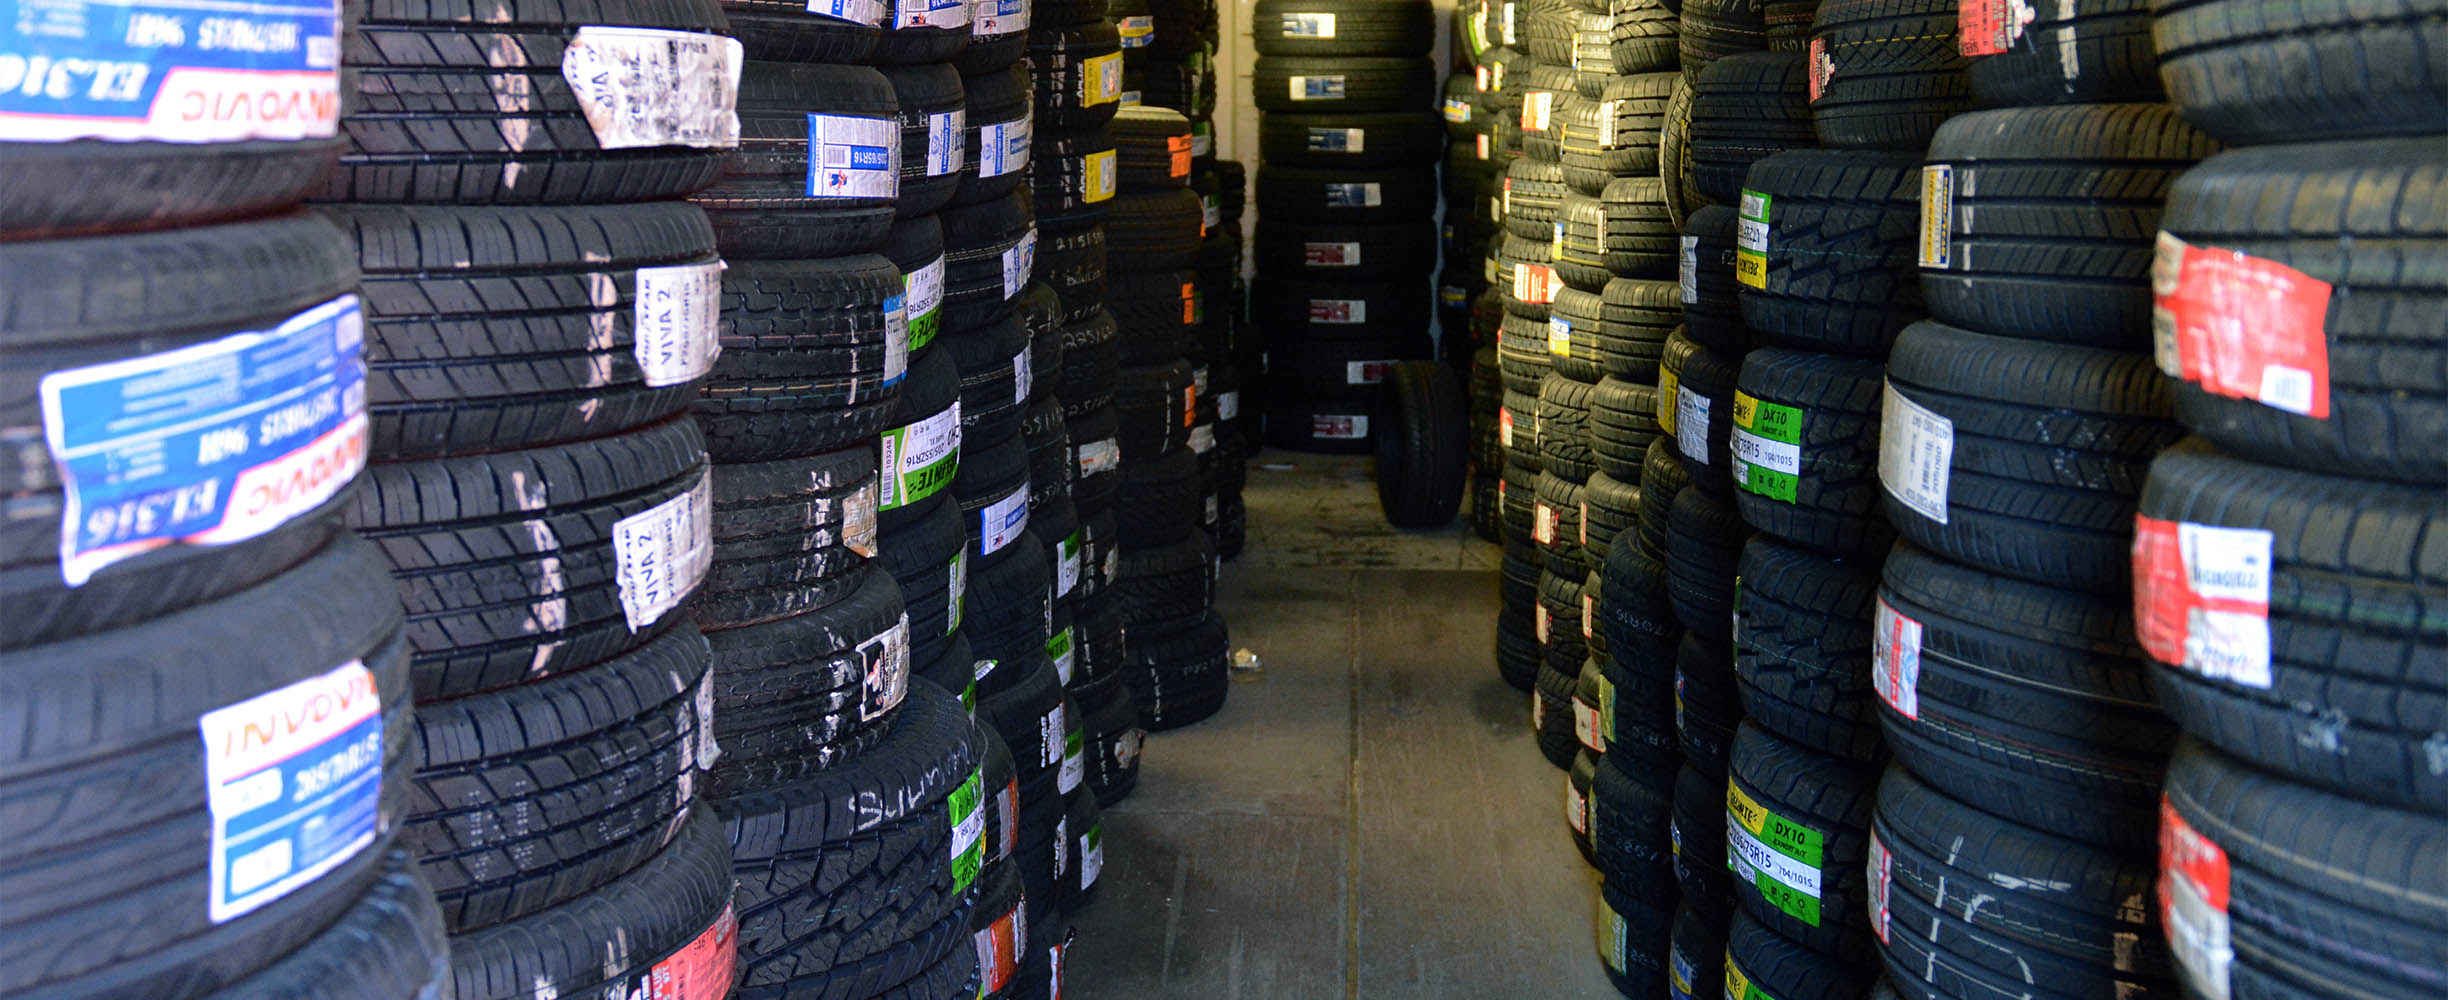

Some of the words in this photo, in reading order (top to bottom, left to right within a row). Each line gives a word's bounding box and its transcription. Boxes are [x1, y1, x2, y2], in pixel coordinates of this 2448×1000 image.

[657, 287, 672, 302] 2
[659, 309, 674, 366] VIVA
[1763, 407, 1787, 425] DX10
[638, 530, 653, 548] 2
[637, 551, 659, 605] VIVA
[1775, 821, 1806, 845] DX10
